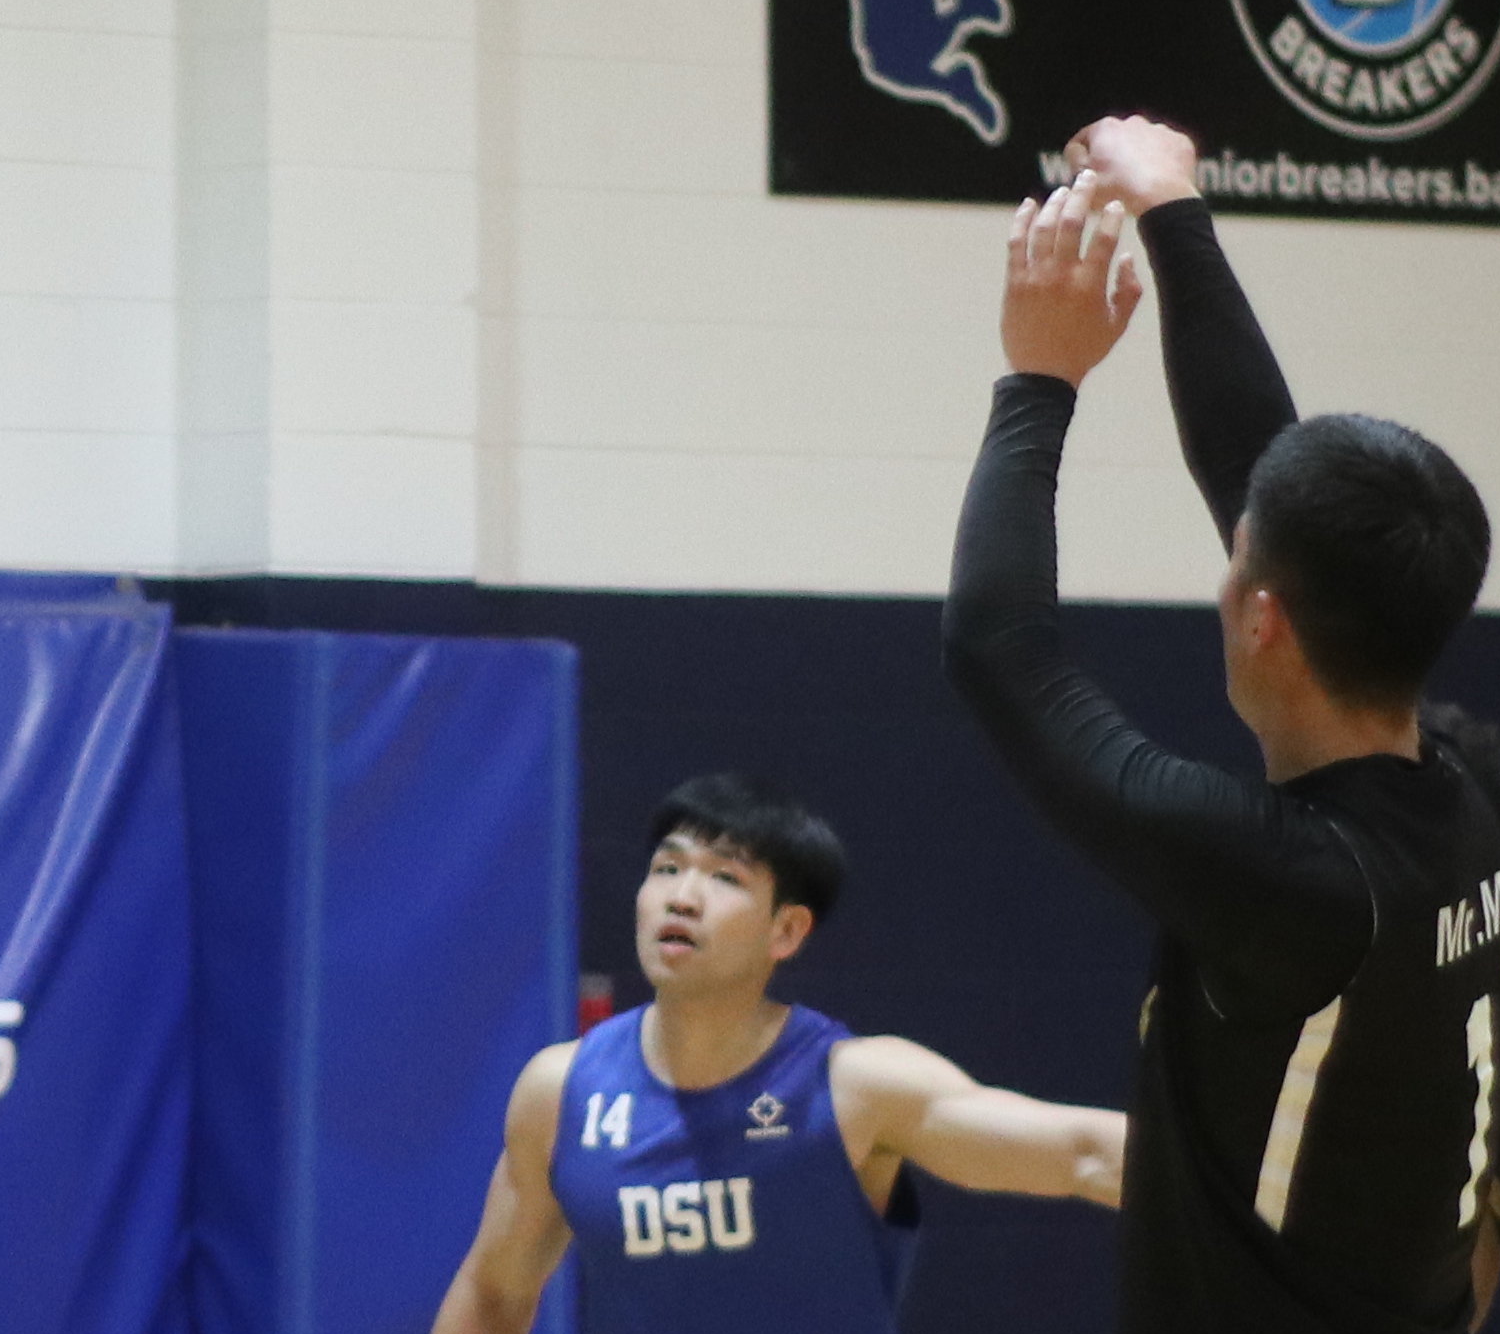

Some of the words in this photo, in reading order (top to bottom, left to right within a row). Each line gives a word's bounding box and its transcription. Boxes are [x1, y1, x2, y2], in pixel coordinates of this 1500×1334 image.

[1268, 14, 1480, 113] BREAKERS
[581, 1091, 634, 1149] 14
[618, 1177, 756, 1258] DSU
